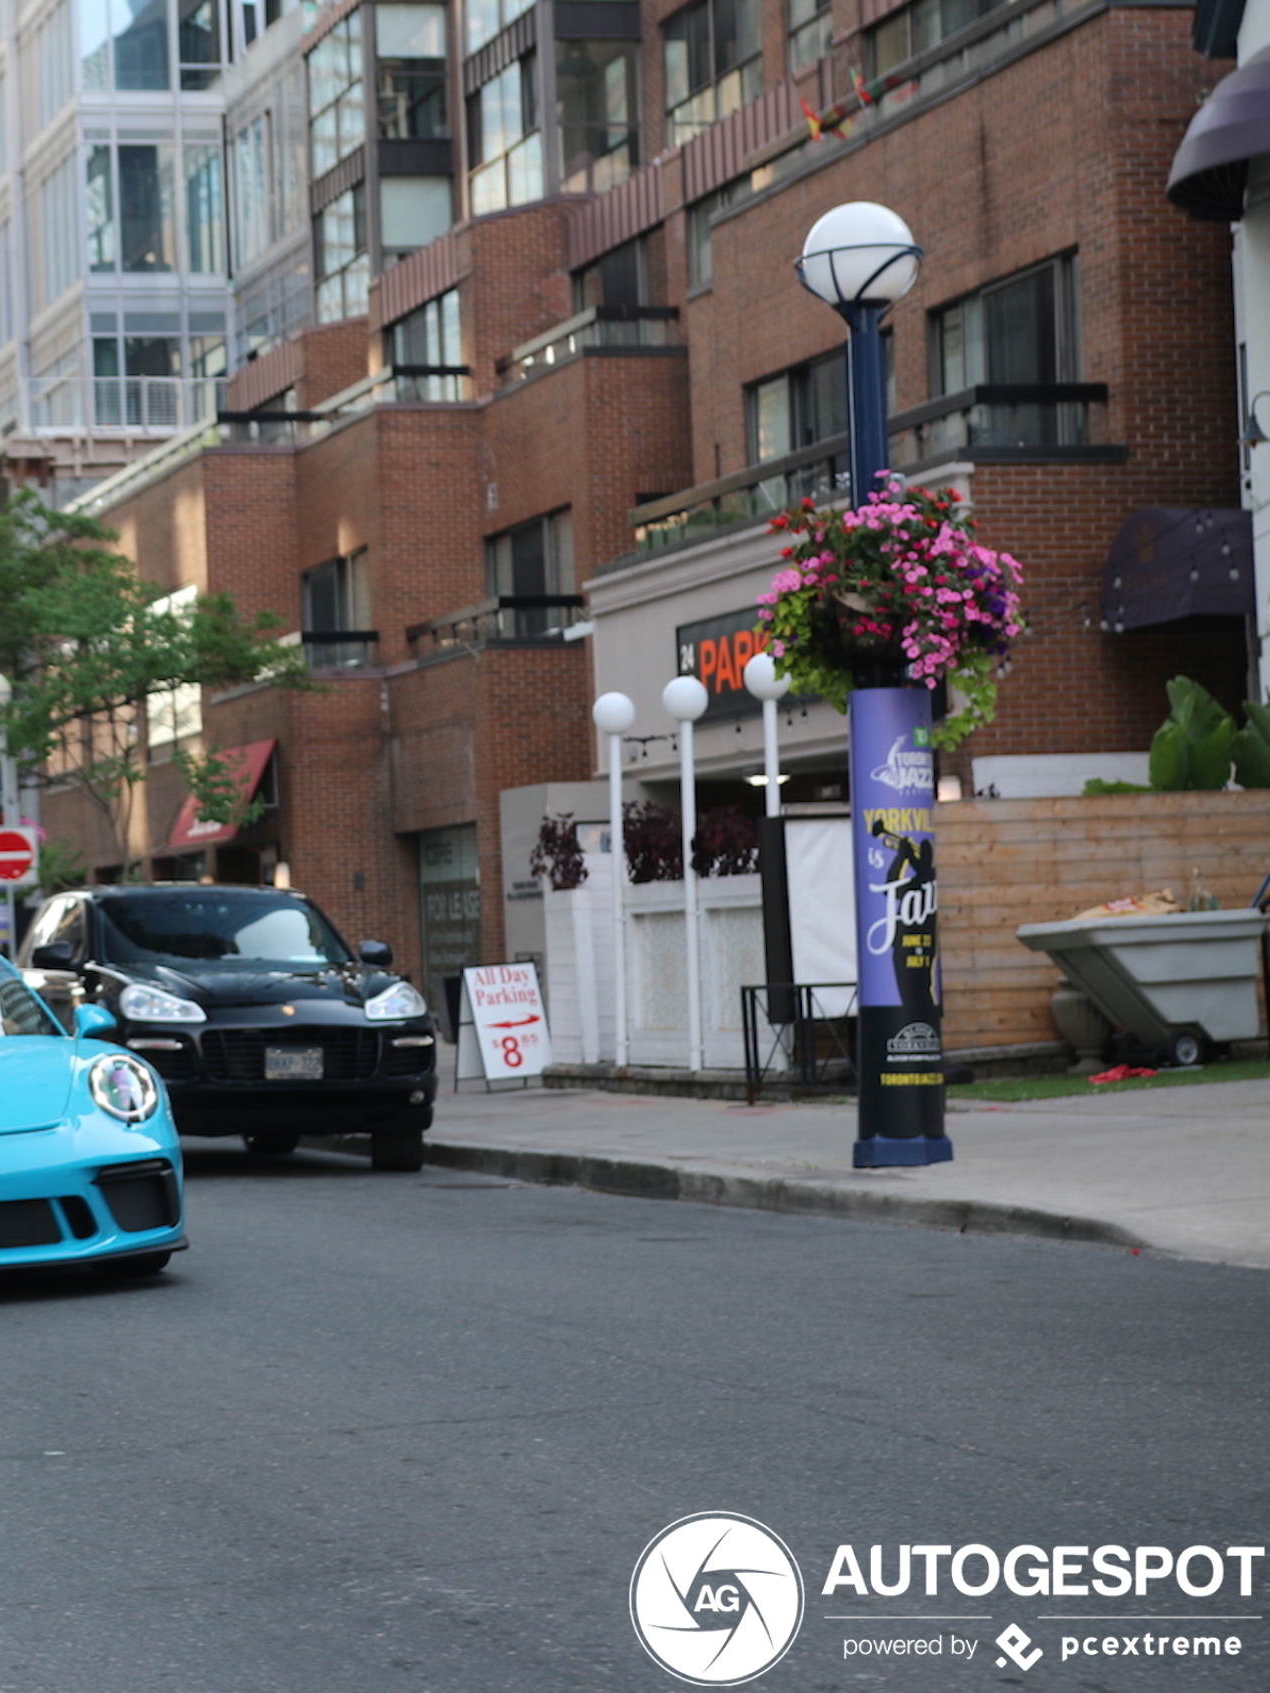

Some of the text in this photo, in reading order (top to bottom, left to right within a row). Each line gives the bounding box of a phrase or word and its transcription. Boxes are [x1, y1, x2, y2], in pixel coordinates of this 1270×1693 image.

[868, 847, 884, 869] is
[475, 965, 529, 987] All Day
[475, 986, 538, 1006] Parking
